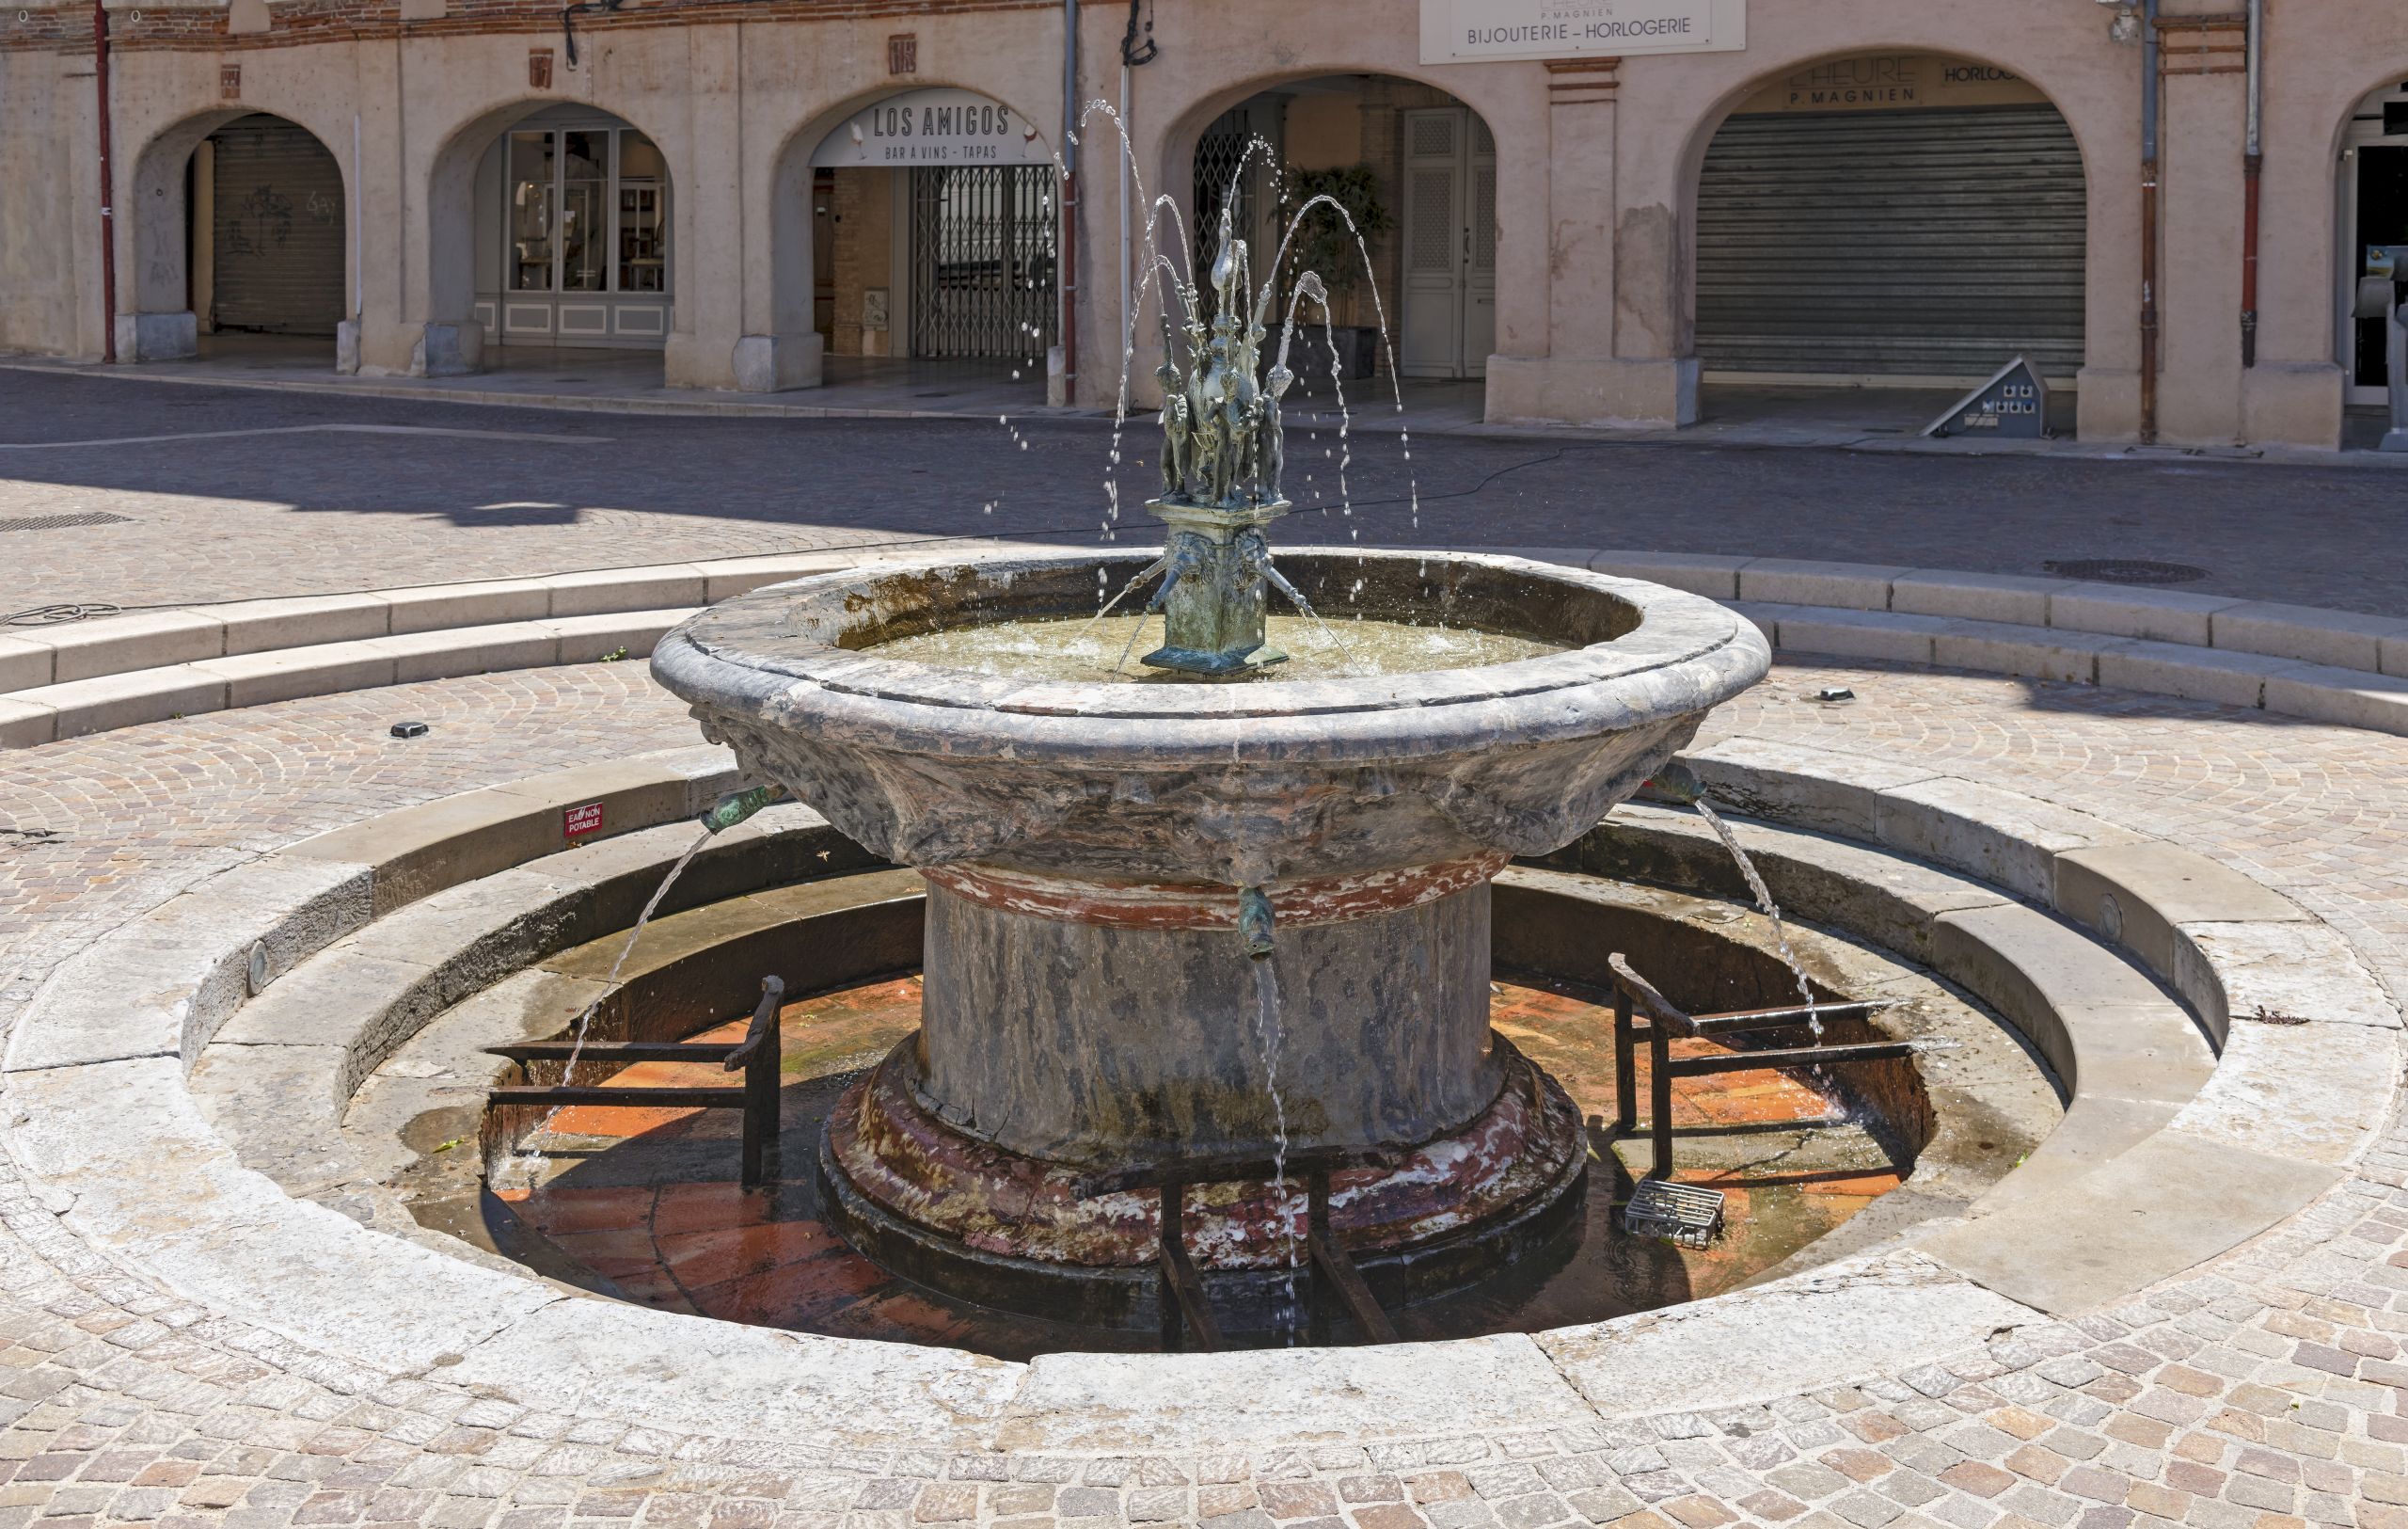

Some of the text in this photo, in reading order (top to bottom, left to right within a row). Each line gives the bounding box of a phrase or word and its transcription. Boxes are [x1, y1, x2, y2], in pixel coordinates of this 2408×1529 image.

[1467, 24, 1568, 44] BIJOUTERIE
[1586, 18, 1691, 39] HORLOGERIE
[874, 105, 1009, 137] LOS AMIGOS
[885, 147, 906, 160] BAR
[921, 146, 948, 160] VINS
[962, 145, 997, 159] TAPAS
[585, 807, 600, 819] NON
[569, 818, 599, 833] POTABLE
